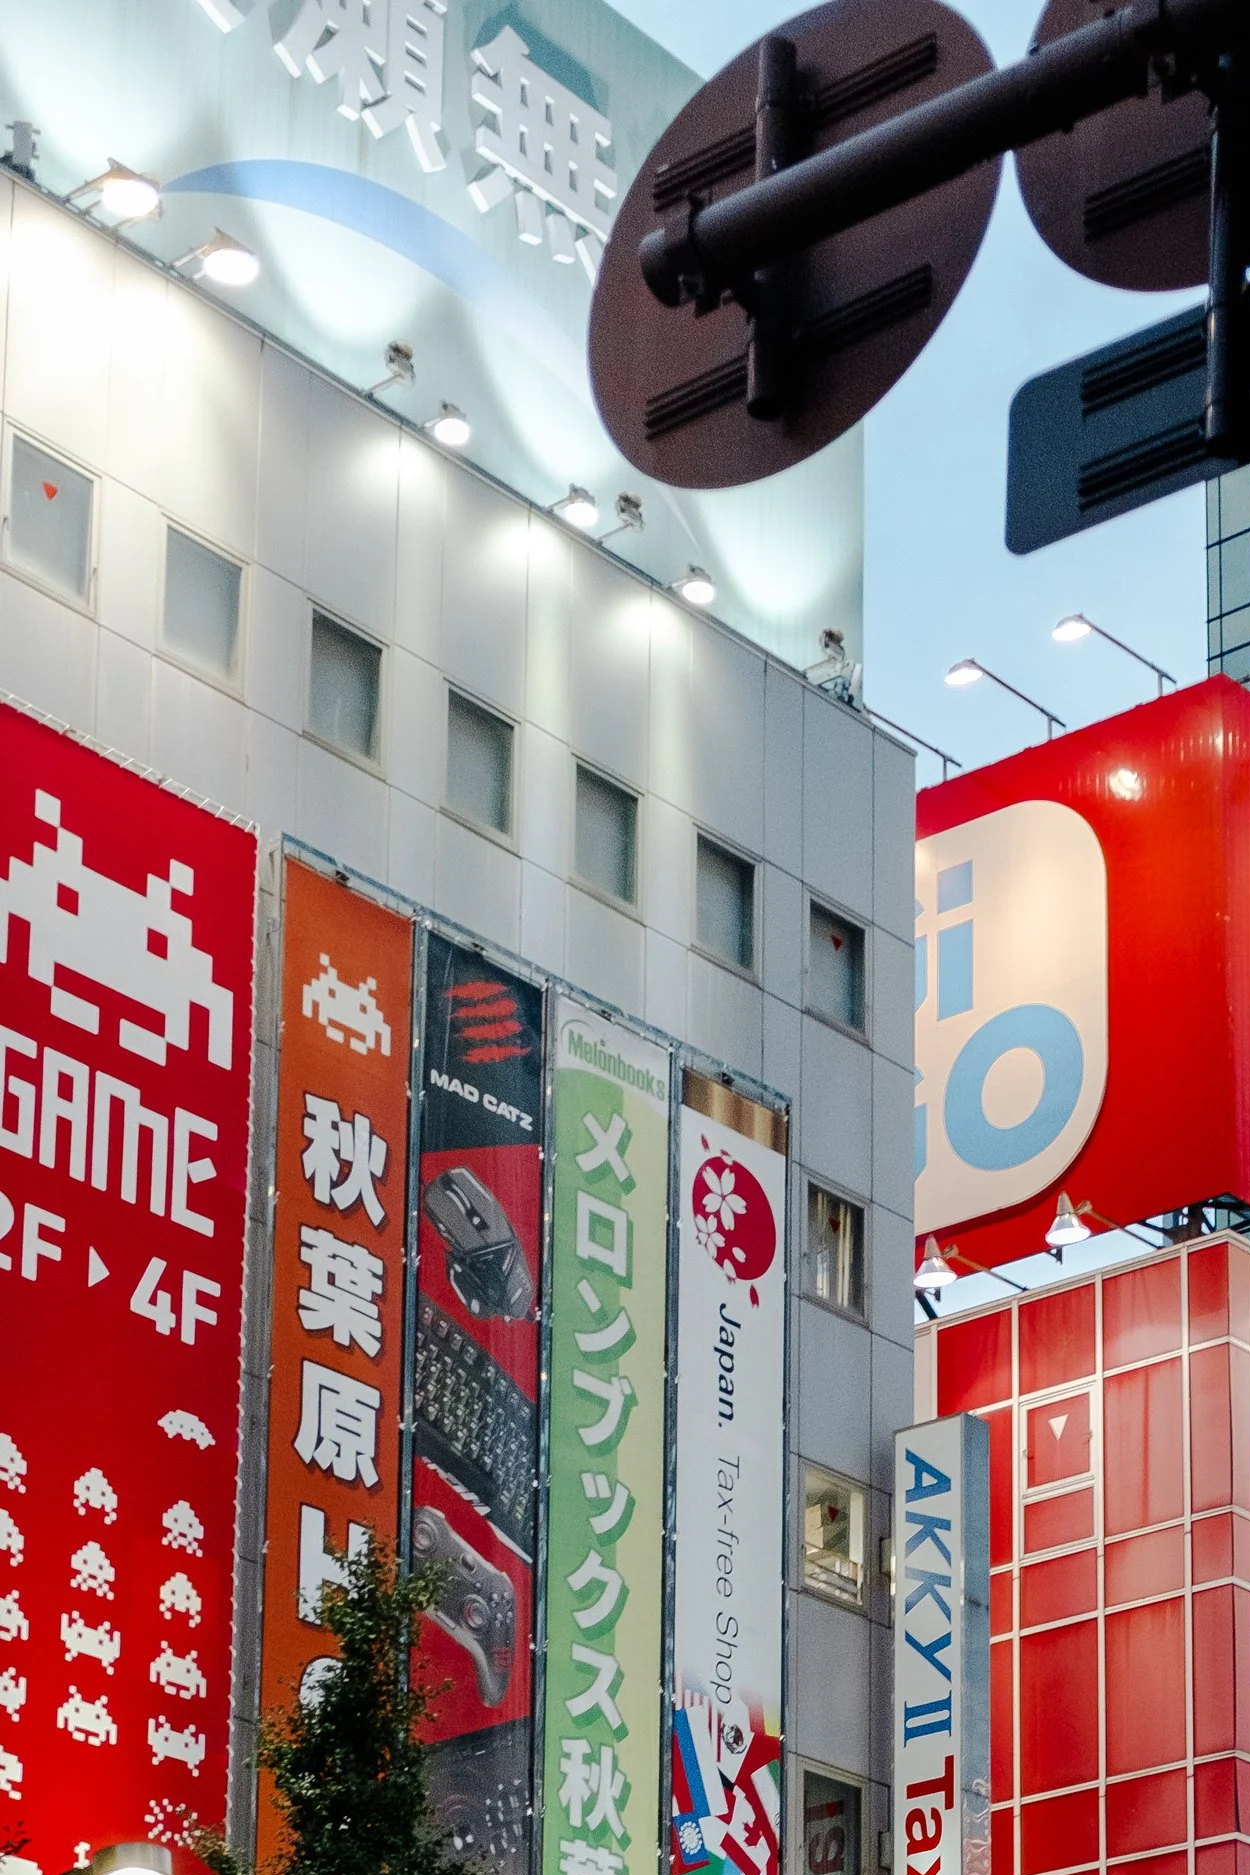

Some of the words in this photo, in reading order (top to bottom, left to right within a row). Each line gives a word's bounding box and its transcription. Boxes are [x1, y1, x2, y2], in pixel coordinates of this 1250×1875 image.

[430, 1069, 480, 1102] MAD
[482, 1090, 535, 1131] CATZ
[566, 1029, 667, 1101] Melonbooks
[130, 1257, 222, 1346] 4F
[717, 1455, 742, 1600] Tax-free
[710, 1617, 740, 1704] Shop
